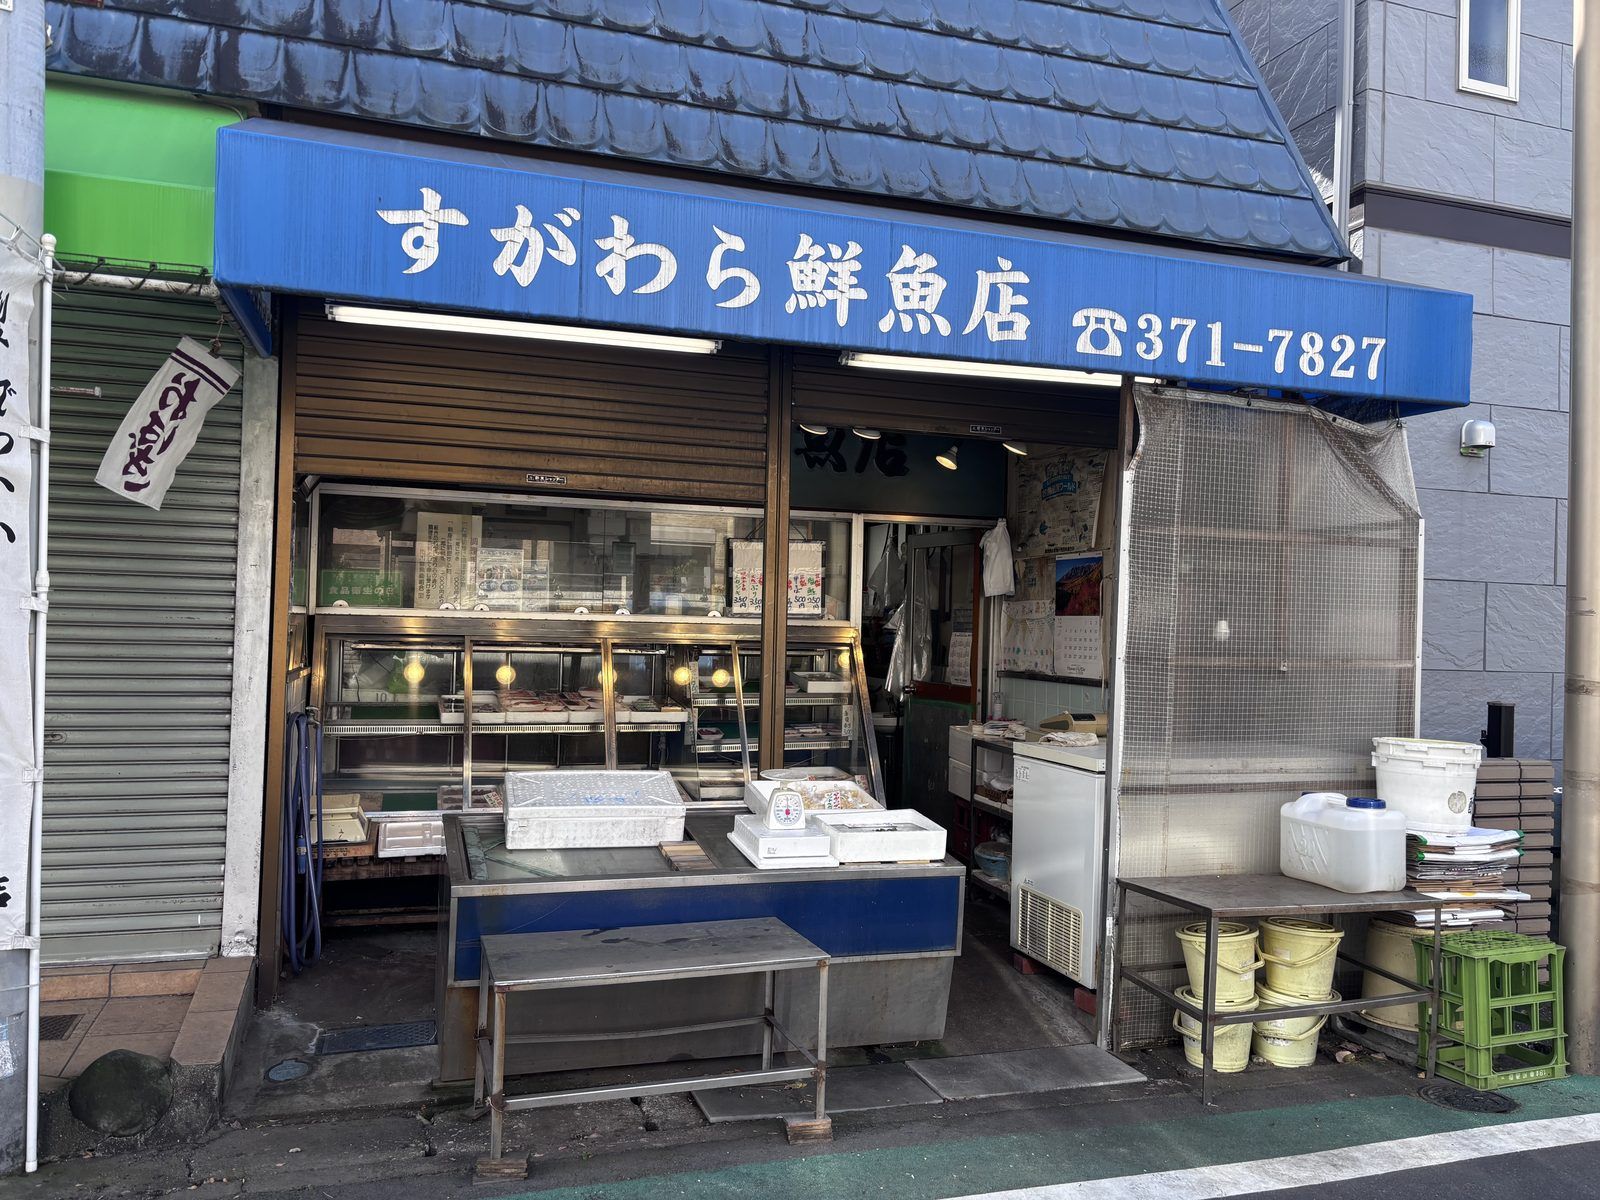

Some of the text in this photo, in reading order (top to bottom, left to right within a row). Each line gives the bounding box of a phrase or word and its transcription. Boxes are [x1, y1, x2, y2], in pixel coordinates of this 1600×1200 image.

[376, 187, 1030, 342] すがわら鮮魚店
[1136, 312, 1386, 380] 371-7827
